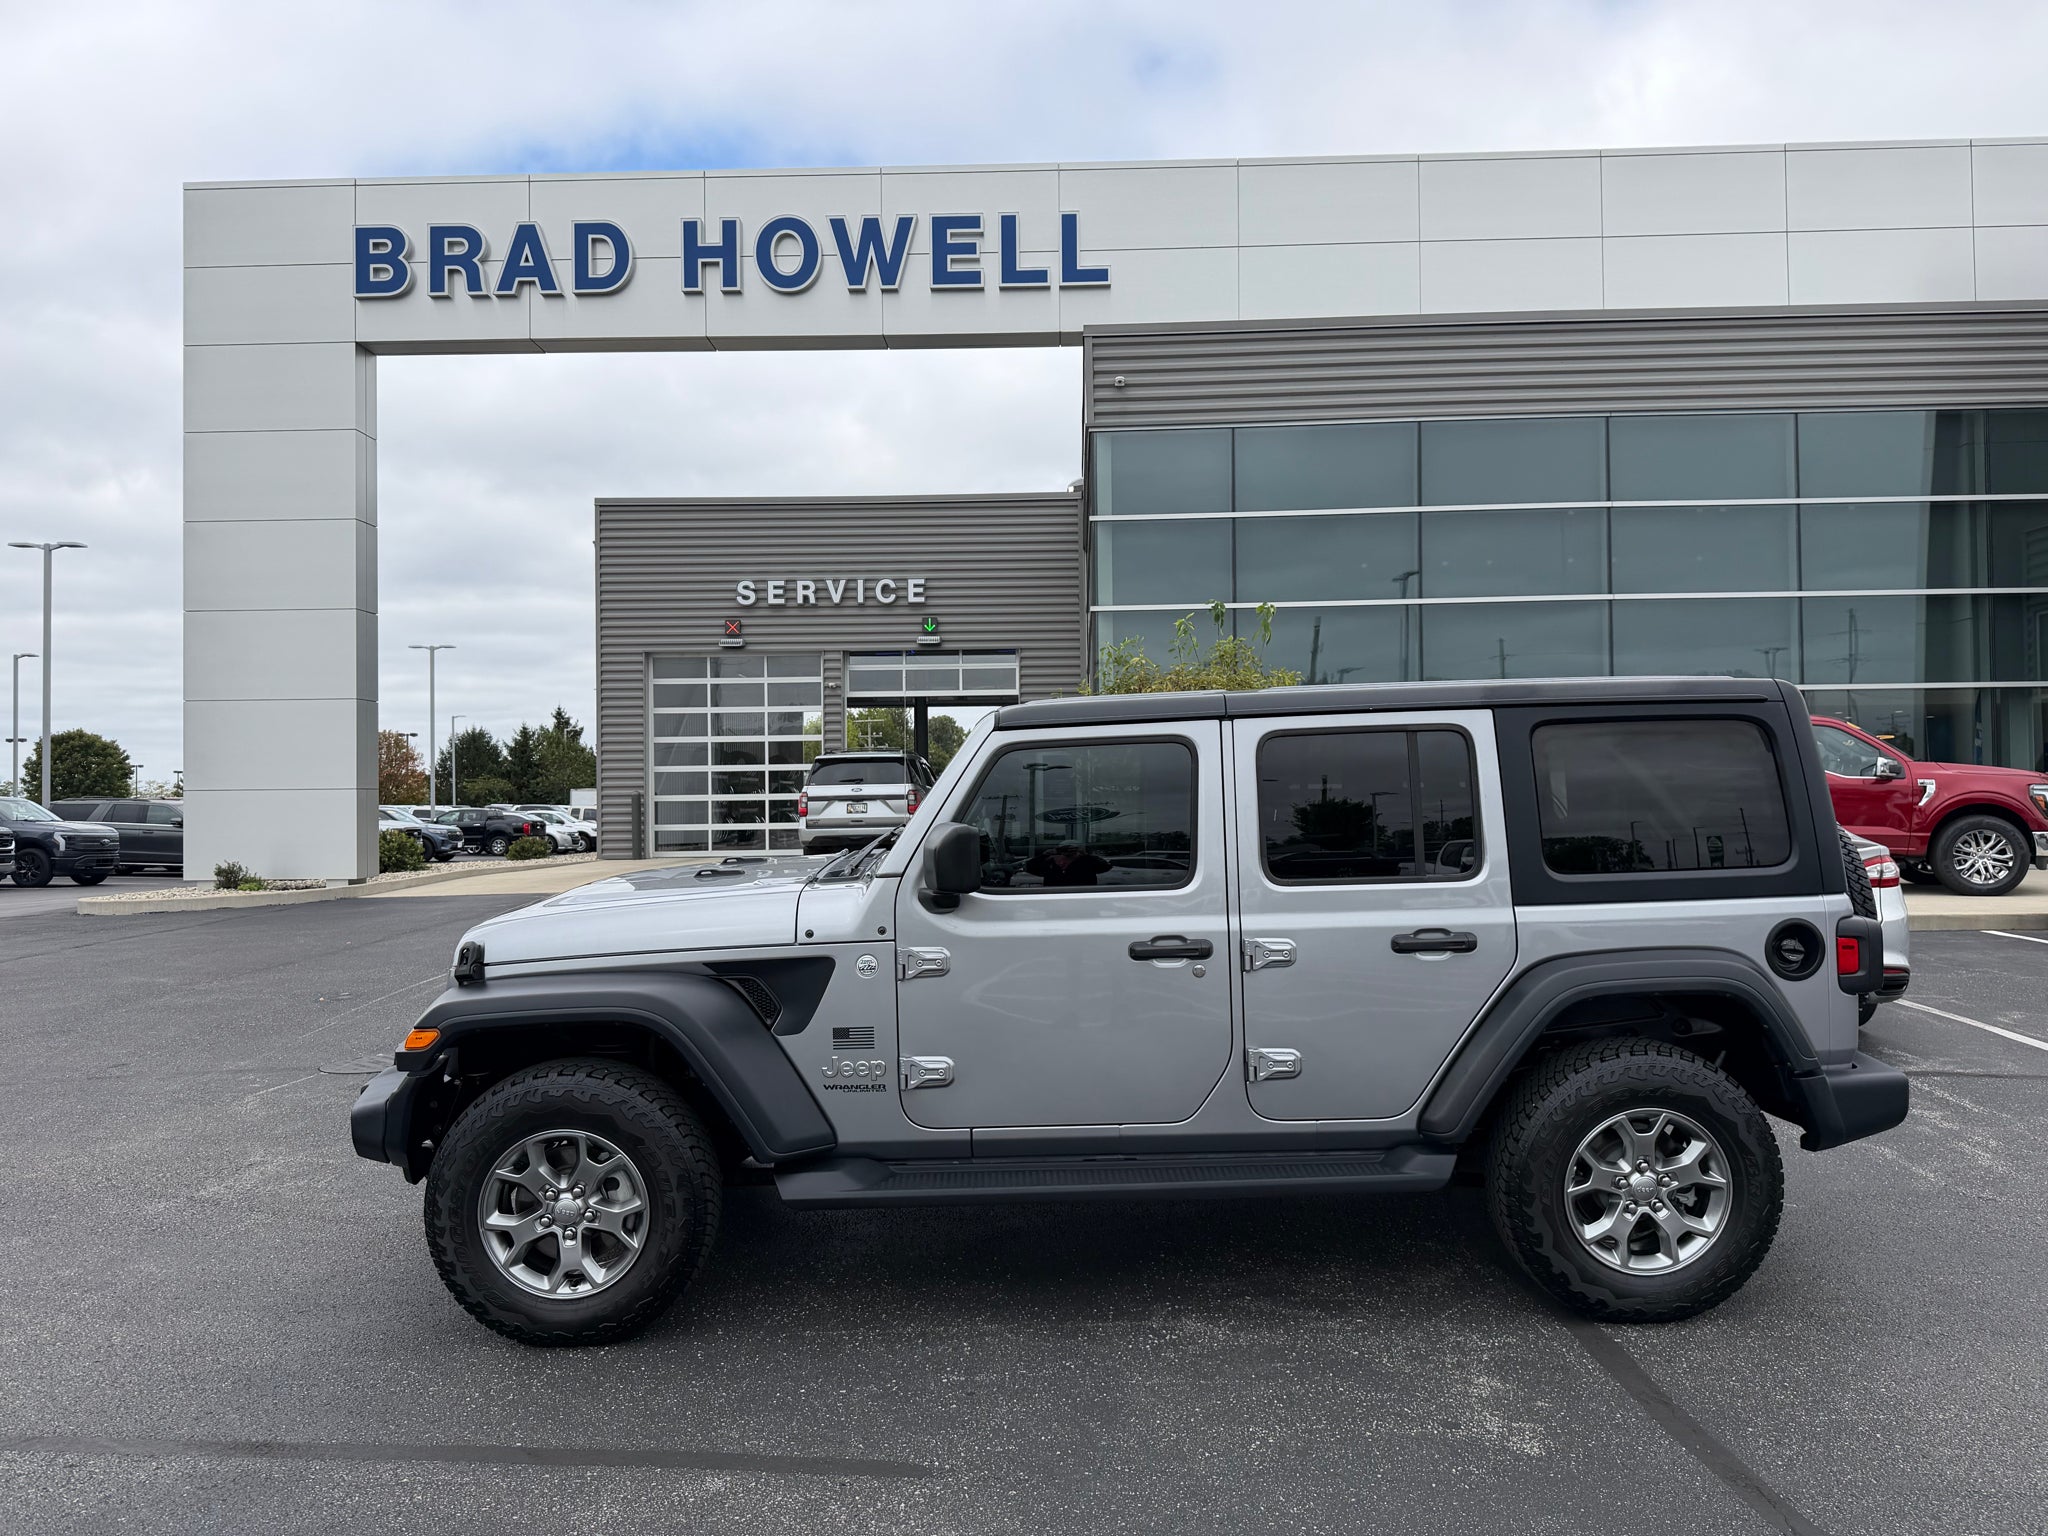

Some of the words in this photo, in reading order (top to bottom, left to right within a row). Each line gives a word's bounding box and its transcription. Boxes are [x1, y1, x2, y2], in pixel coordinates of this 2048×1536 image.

[352, 220, 636, 298] BRAD
[679, 210, 1112, 295] HOWELL
[735, 578, 926, 606] SERVICE
[821, 1056, 887, 1081] Jeep
